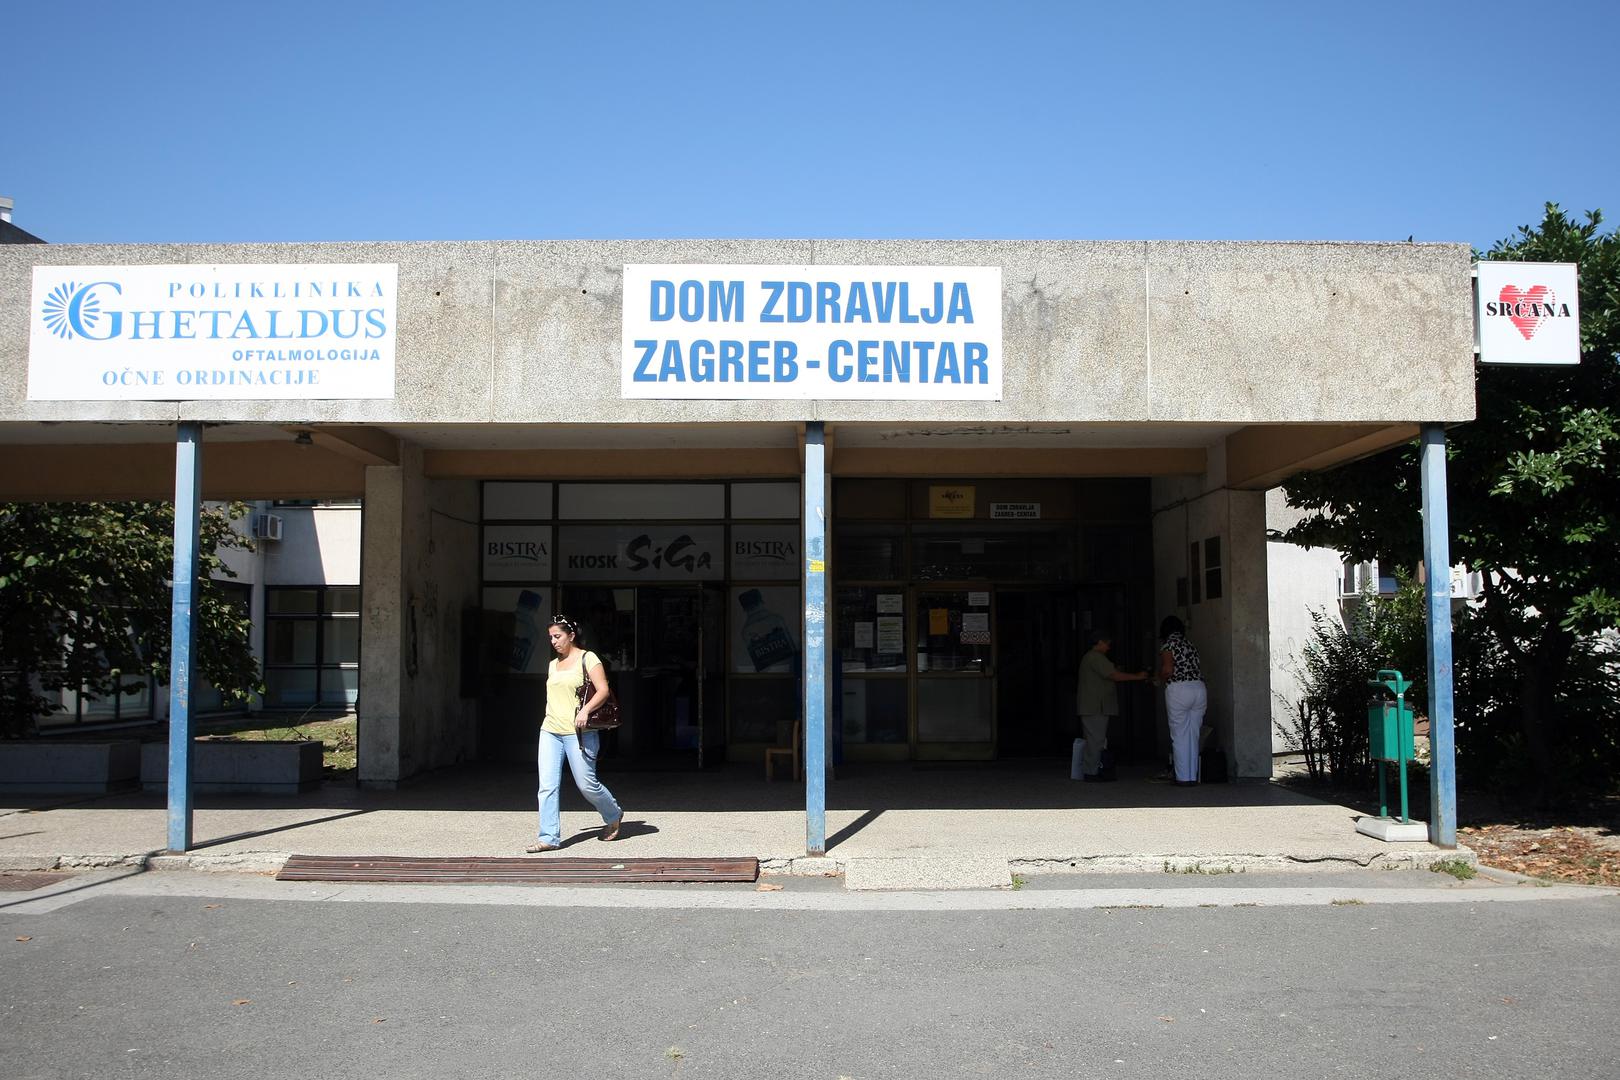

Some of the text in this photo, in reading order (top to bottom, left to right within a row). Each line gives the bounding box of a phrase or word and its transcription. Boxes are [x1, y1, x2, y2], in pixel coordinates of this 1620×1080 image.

[169, 281, 384, 298] POLIKLINIKA
[68, 281, 386, 341] GHETALDUS
[650, 280, 974, 324] DOM ZDRAVLJA
[1486, 298, 1571, 317] SRČANA
[232, 349, 380, 361] OFTALMOLOGIJA
[633, 340, 989, 385] ZAGREB-CENTAR
[102, 367, 320, 386] OČNE ORDINACIJE
[488, 542, 547, 557] BISTRA
[736, 541, 795, 556] BISTRA
[568, 555, 618, 569] KIOSK
